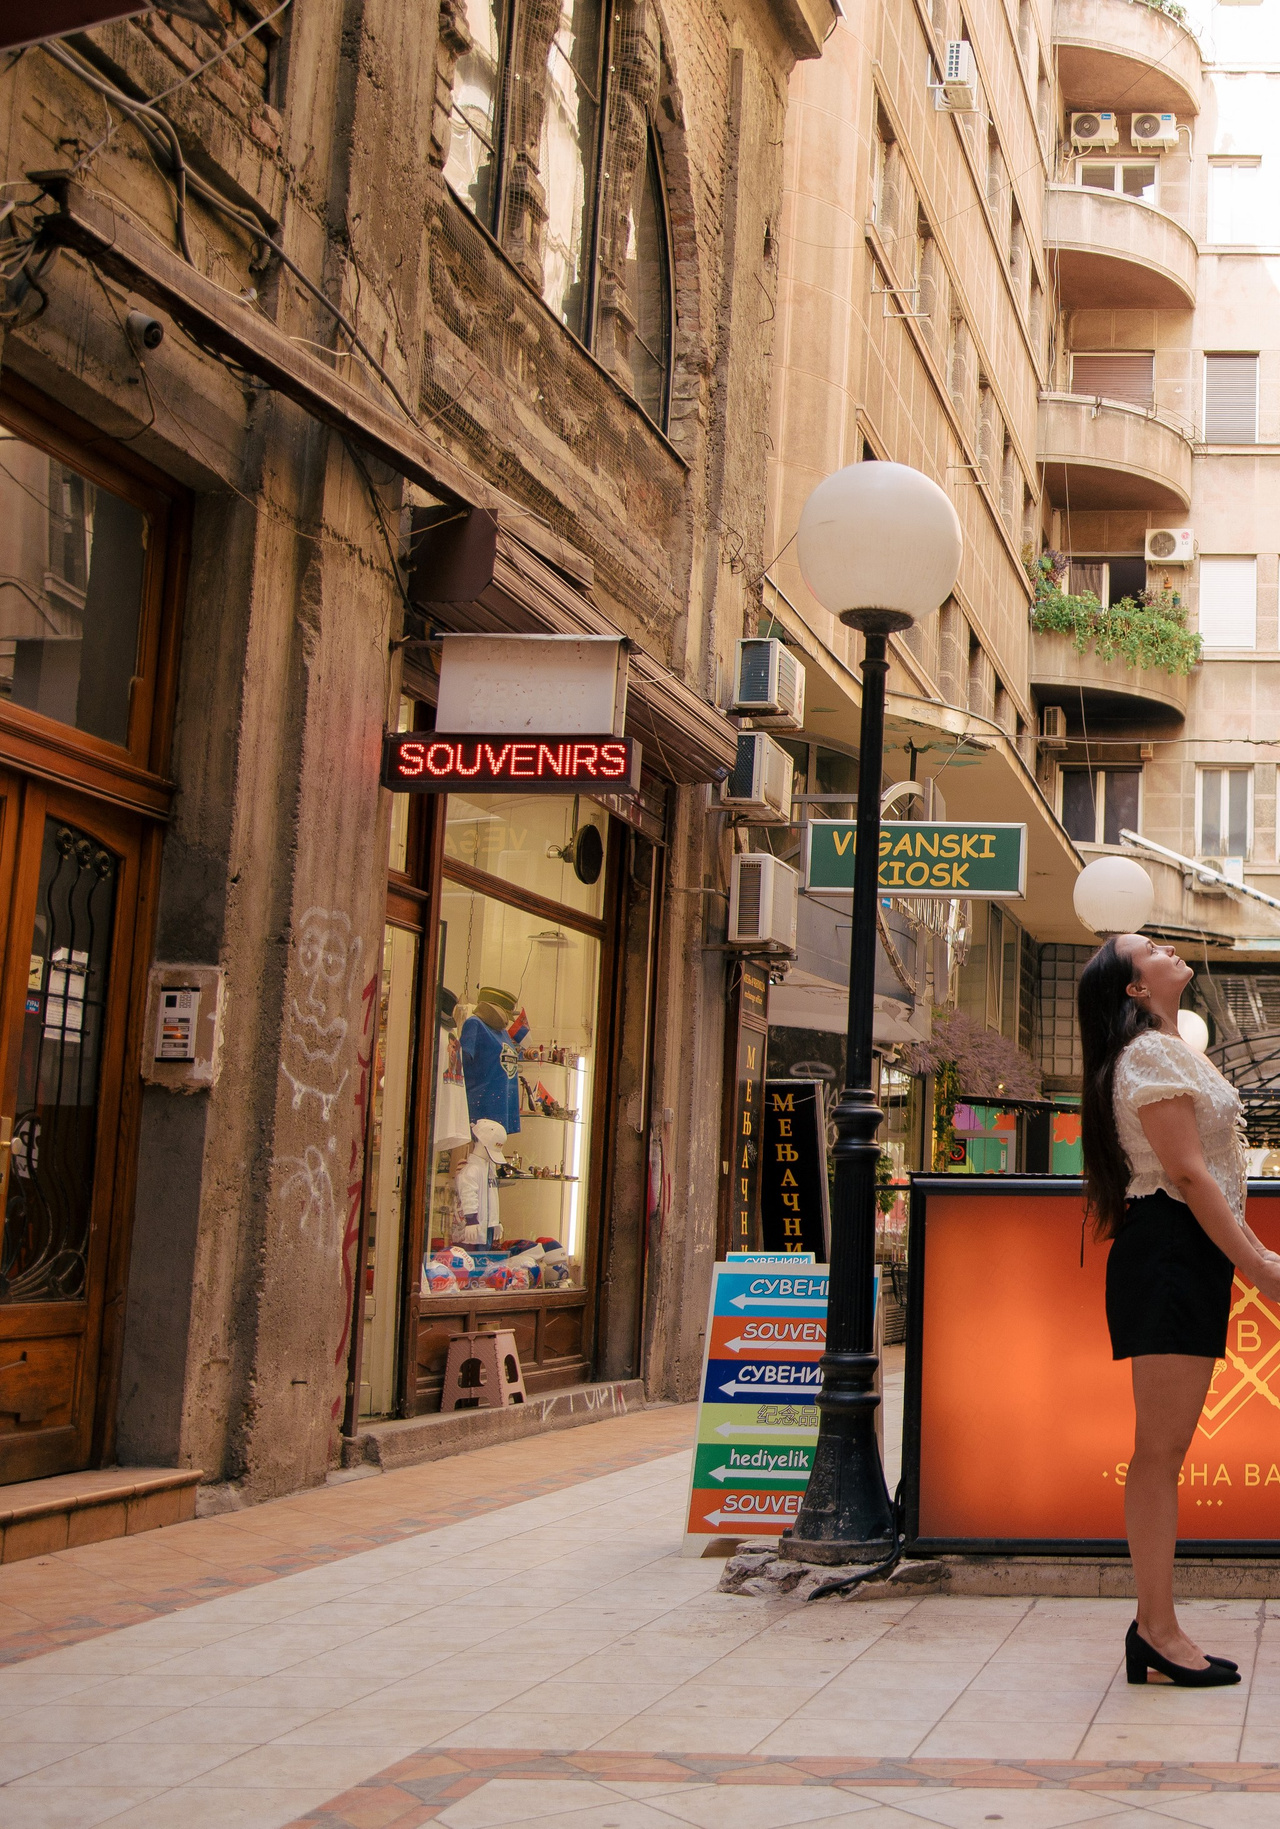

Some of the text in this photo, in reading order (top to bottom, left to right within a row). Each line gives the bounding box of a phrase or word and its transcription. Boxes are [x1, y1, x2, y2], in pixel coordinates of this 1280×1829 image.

[399, 743, 626, 776] SOUVENIRS
[832, 831, 997, 859] VGANSKI
[877, 861, 970, 888] KIOSK
[741, 1045, 756, 1252] МЕЊАЧН
[749, 1278, 829, 1296] СУВЕН
[738, 1365, 825, 1384] СУВЕНИ
[757, 1404, 819, 1427] 纪念品
[730, 1448, 809, 1472] hediyelik
[1114, 1462, 1232, 1487] SHA
